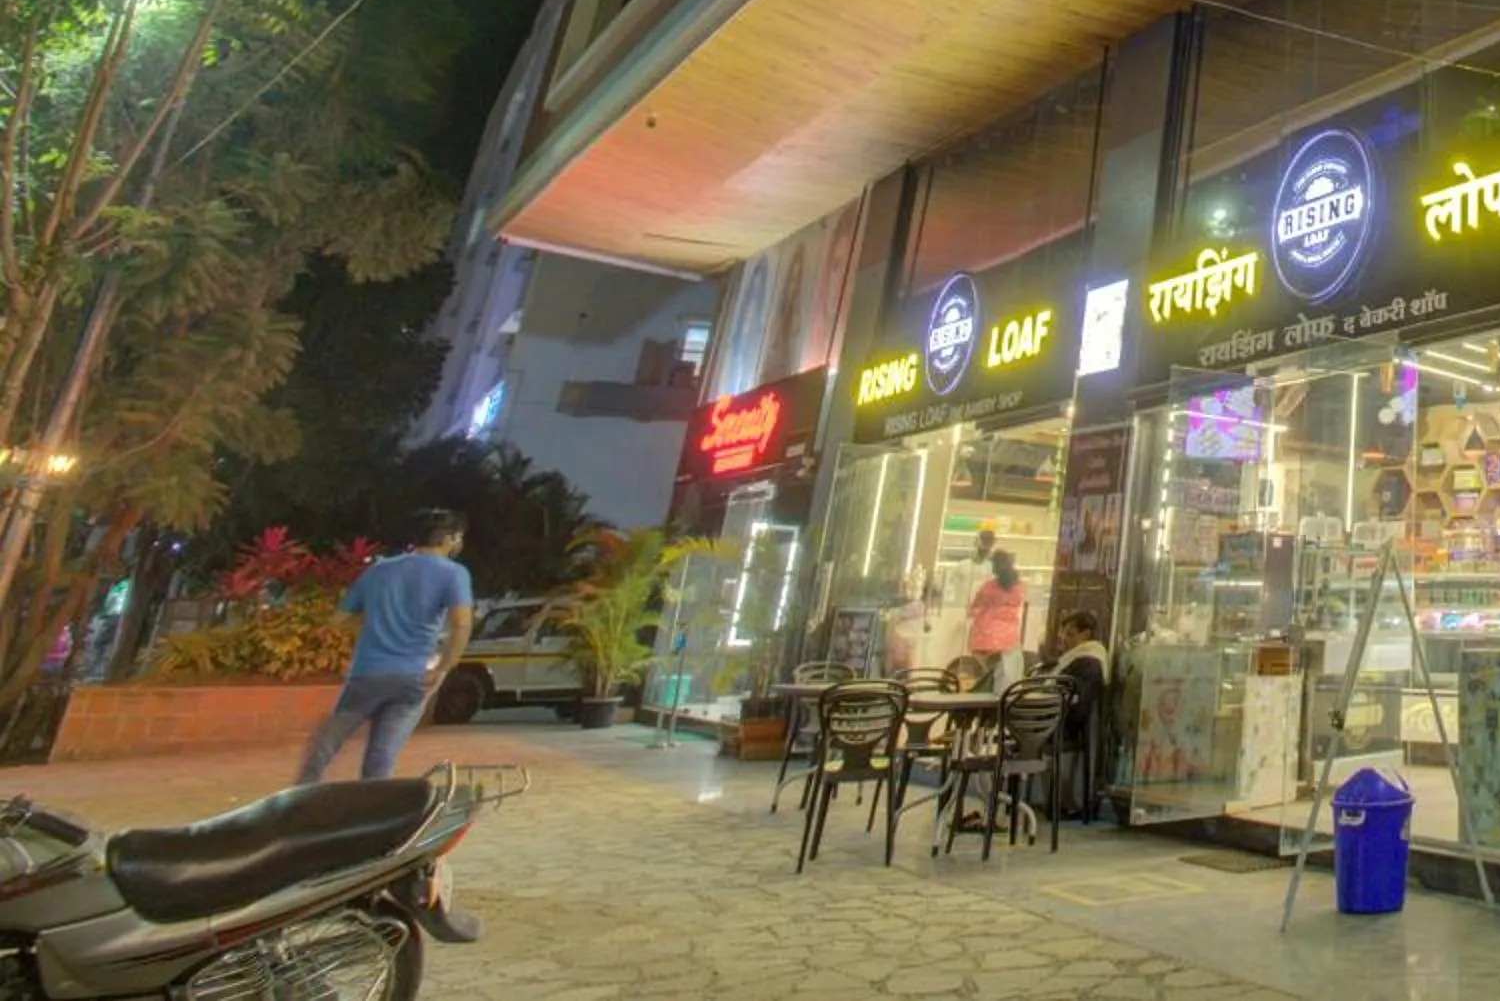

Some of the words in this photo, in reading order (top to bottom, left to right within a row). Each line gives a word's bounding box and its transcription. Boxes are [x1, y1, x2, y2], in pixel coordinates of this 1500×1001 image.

[1282, 193, 1357, 237] RISING
[1148, 246, 1258, 323] रायझिंग
[987, 310, 1052, 368] LOAF
[1284, 312, 1335, 346] लोफ
[857, 354, 919, 406] RISING
